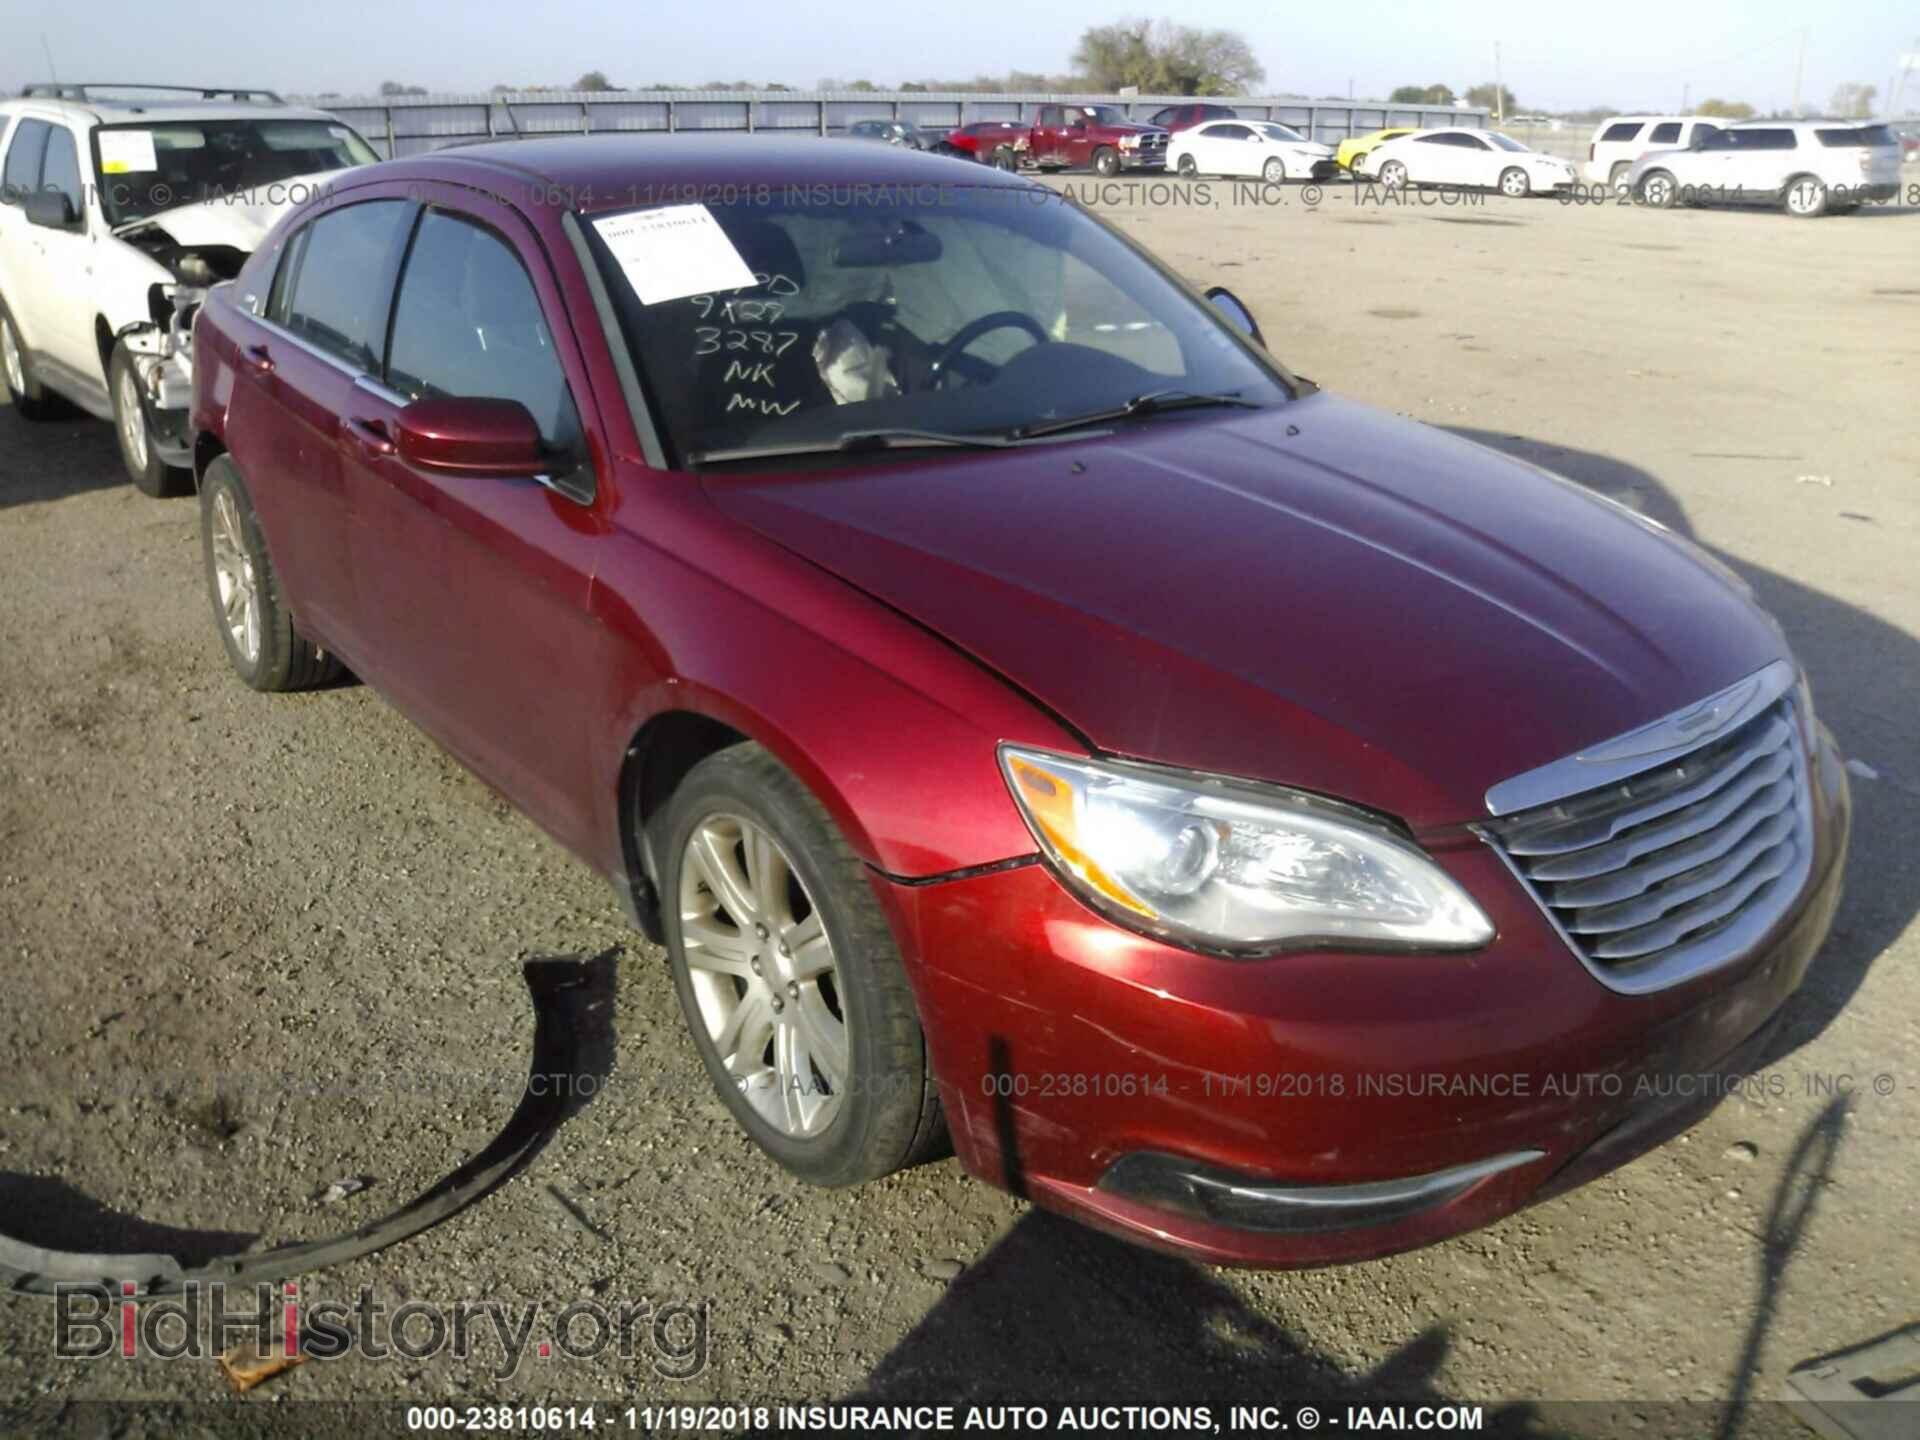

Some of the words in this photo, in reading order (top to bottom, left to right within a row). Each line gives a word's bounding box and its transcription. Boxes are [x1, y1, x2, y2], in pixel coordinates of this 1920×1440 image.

[694, 326, 799, 357] 3287
[723, 360, 776, 388] NK
[725, 392, 802, 416] MW
